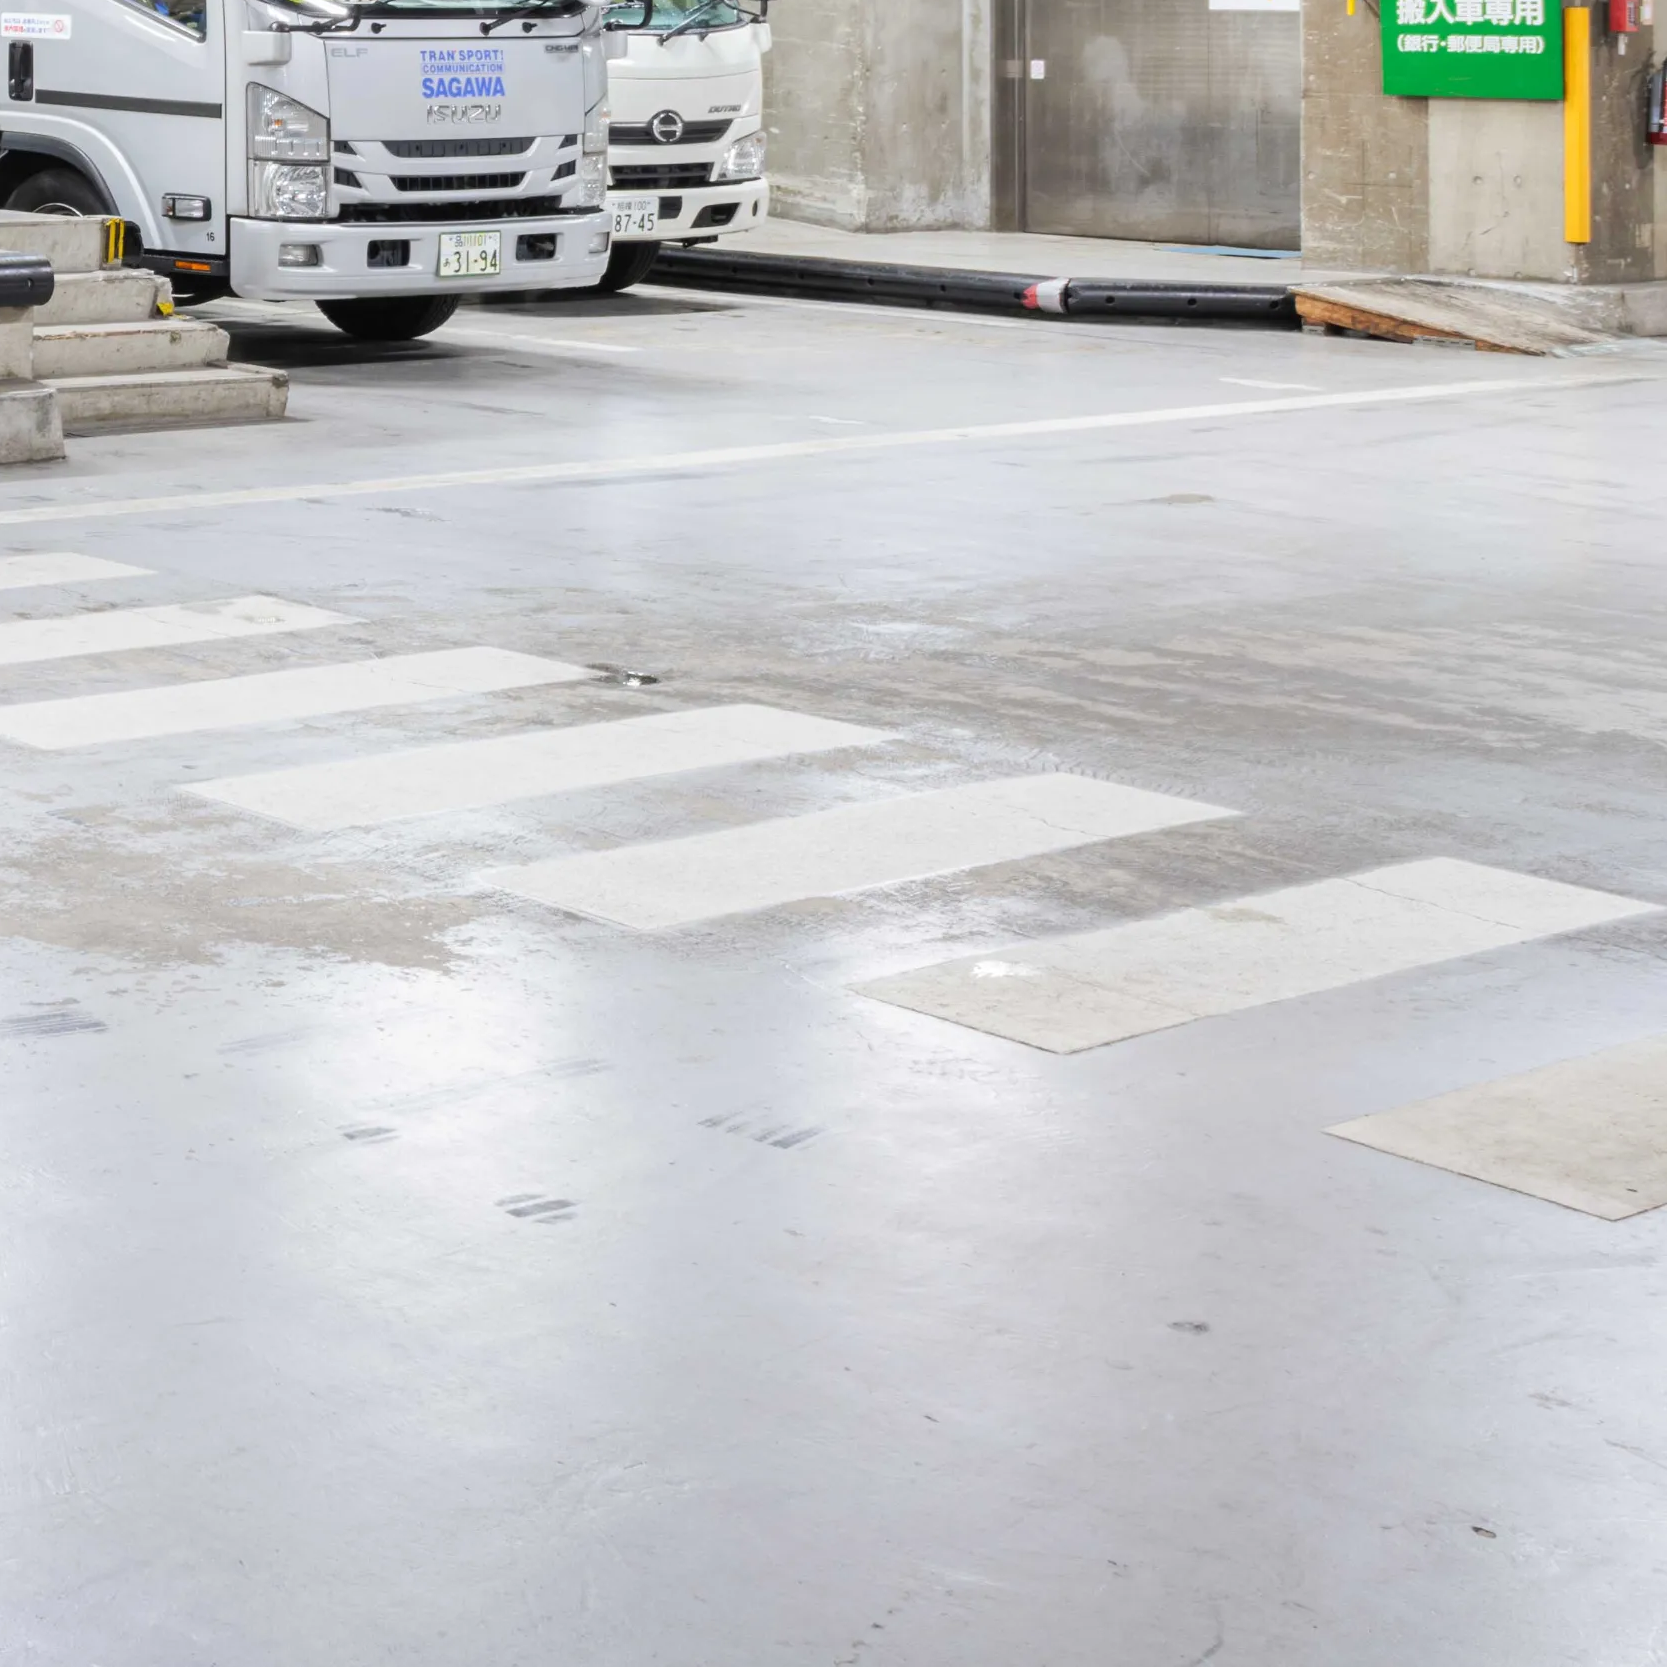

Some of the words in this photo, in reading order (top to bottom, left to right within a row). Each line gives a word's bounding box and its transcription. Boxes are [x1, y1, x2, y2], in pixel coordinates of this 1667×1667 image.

[423, 62, 503, 74] COMMUNICATION
[422, 76, 506, 99] SAGAWA
[427, 103, 502, 125] ISUZU
[615, 213, 655, 233] 87-45
[206, 231, 215, 242] 16
[453, 248, 498, 274] 31-94
